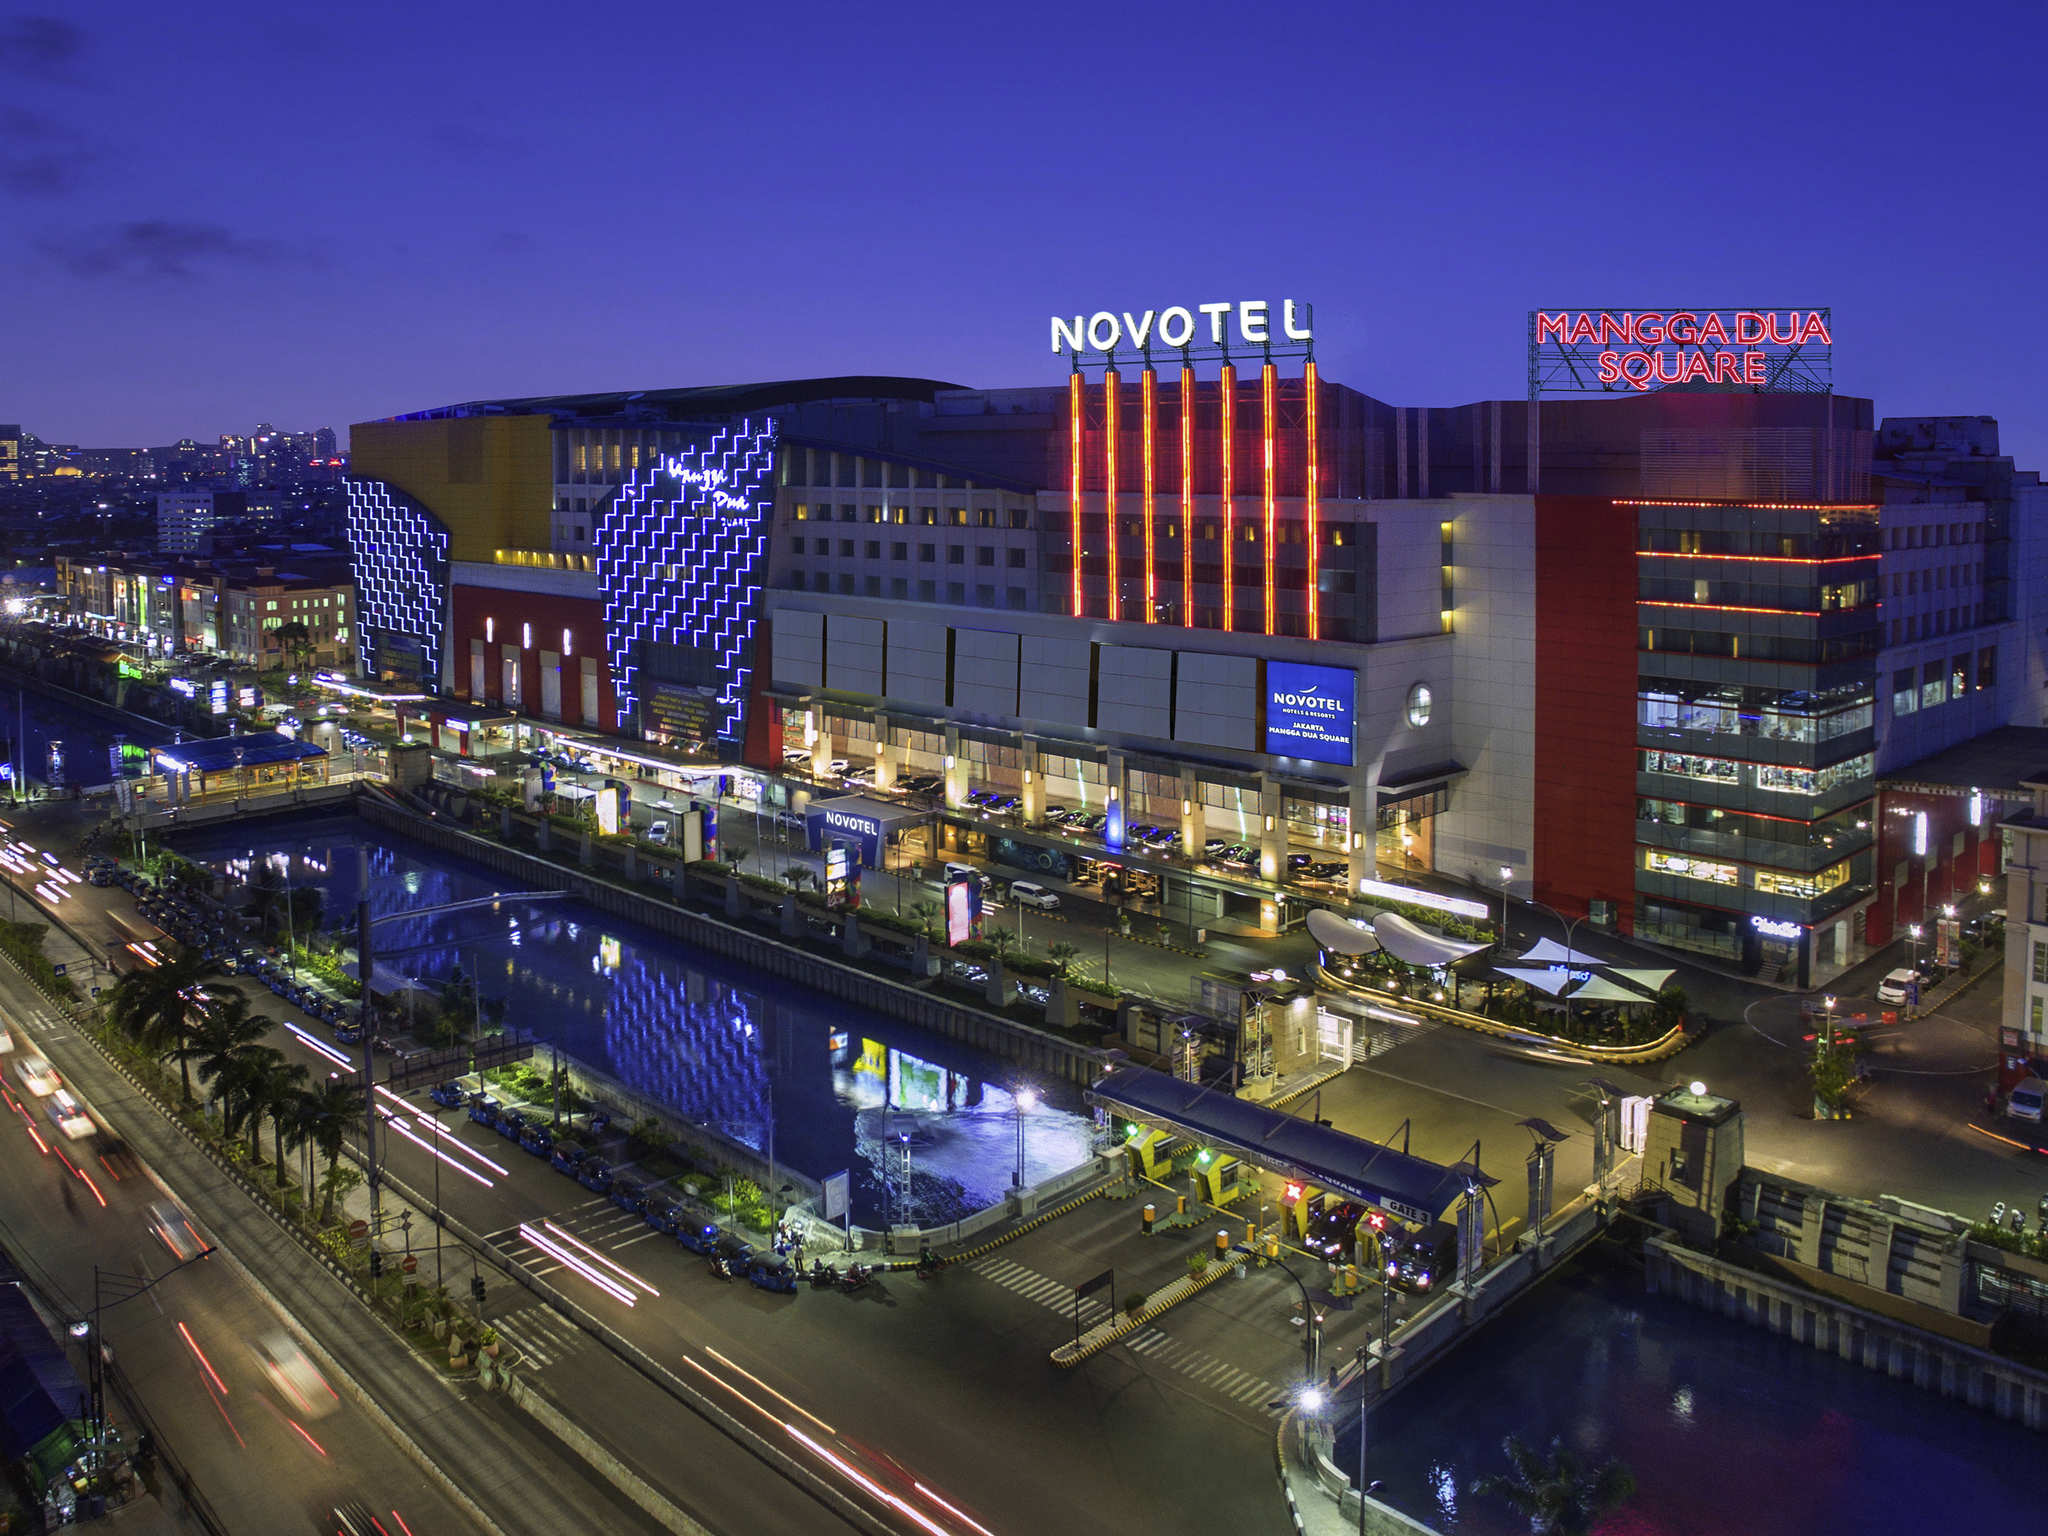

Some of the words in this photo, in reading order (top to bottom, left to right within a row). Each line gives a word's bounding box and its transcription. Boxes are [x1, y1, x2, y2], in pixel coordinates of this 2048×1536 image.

[1051, 299, 1312, 354] NOVOTEL
[1537, 312, 1728, 345] MANGGA
[1735, 312, 1832, 345] DUA
[1599, 351, 1766, 390] SQUARE
[1274, 692, 1344, 712] NOVOTEL
[1282, 708, 1304, 716] HOTELS
[1310, 711, 1336, 720] RESORTS
[1269, 727, 1301, 737] MANGGA
[1302, 731, 1318, 739] DUA
[1319, 733, 1350, 744] SQUARE
[1293, 722, 1325, 732] JAKARTA
[826, 811, 878, 836] NOVOTEL
[1389, 1200, 1418, 1220] GATE
[1420, 1209, 1429, 1223] 3
